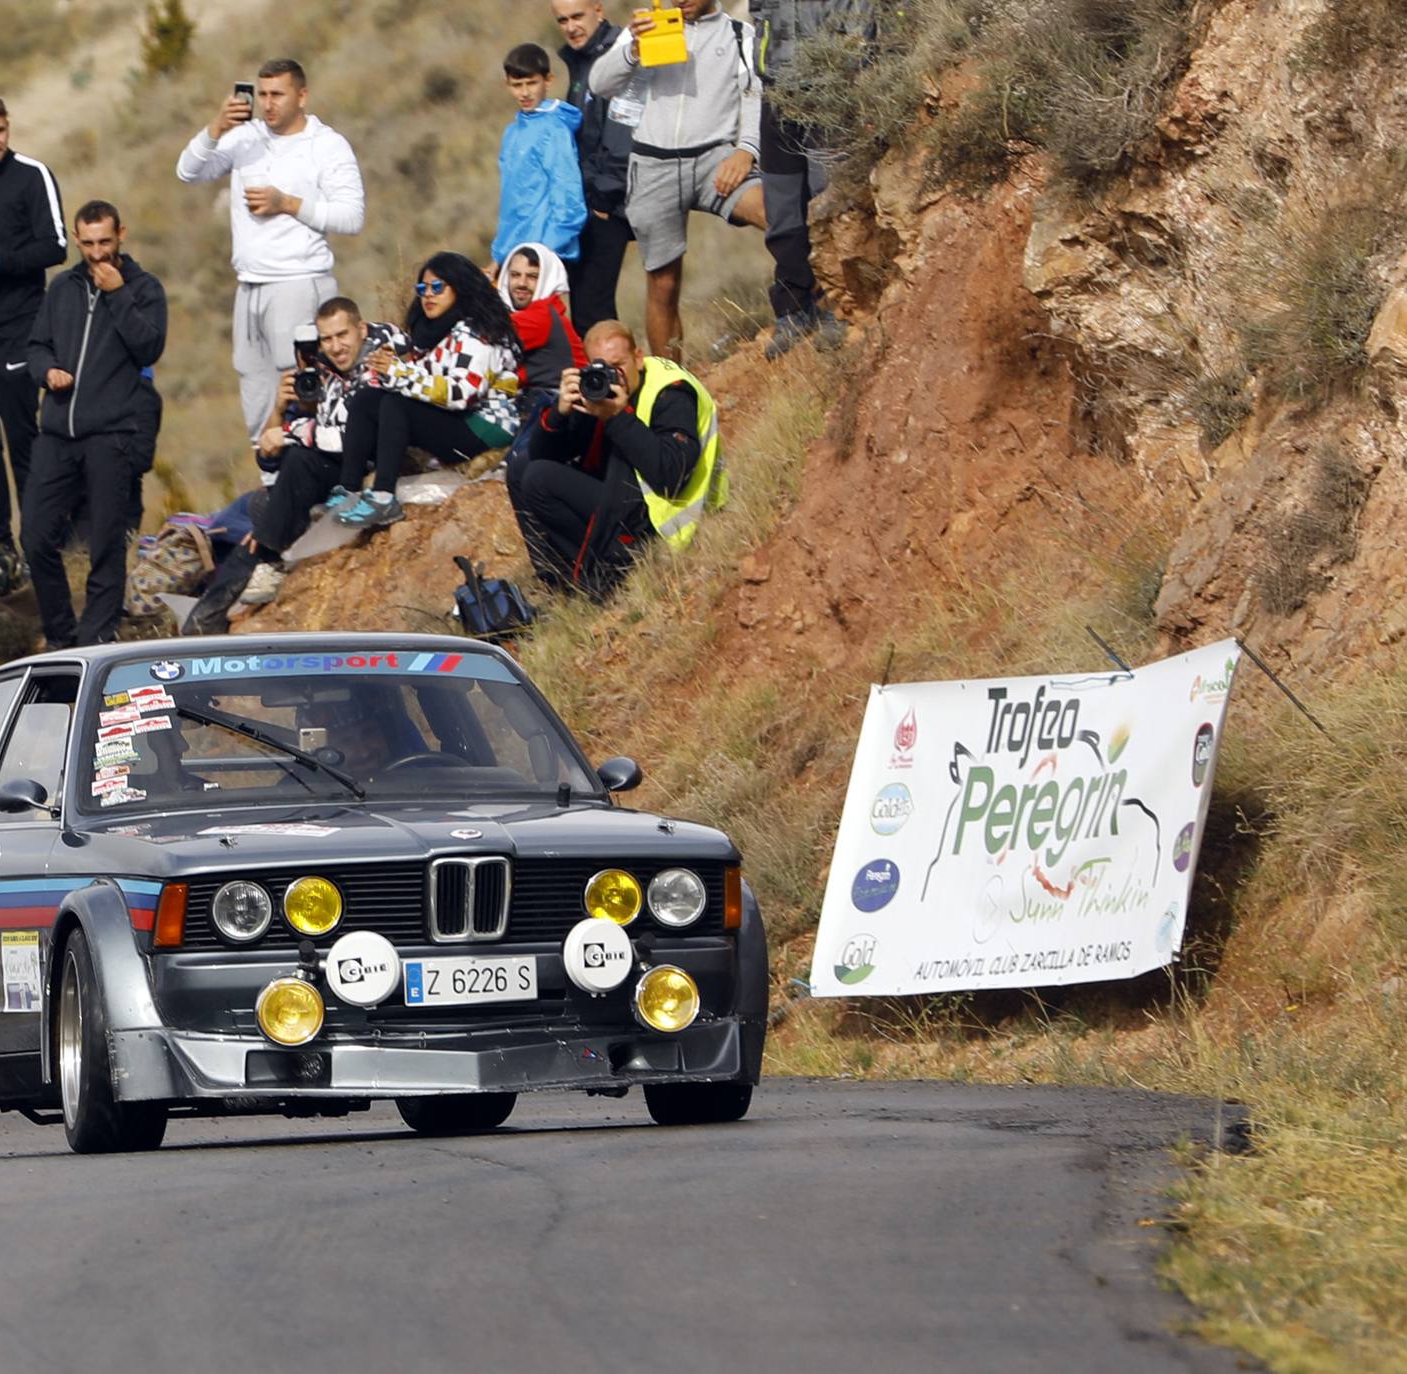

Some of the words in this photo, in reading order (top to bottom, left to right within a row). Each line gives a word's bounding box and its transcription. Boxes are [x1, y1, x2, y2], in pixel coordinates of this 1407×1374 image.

[191, 653, 400, 676] Motorsport
[987, 685, 1080, 769] Trofeo
[913, 952, 984, 979] AUTOMÓVIL
[989, 954, 1019, 975] CLUB
[1019, 949, 1075, 972] ZARCILLA
[1076, 945, 1093, 967] DE
[1094, 941, 1132, 963] RAMOS
[410, 987, 420, 998] E
[426, 970, 440, 995] Z
[452, 966, 508, 993] 6226
[518, 965, 531, 991] S
